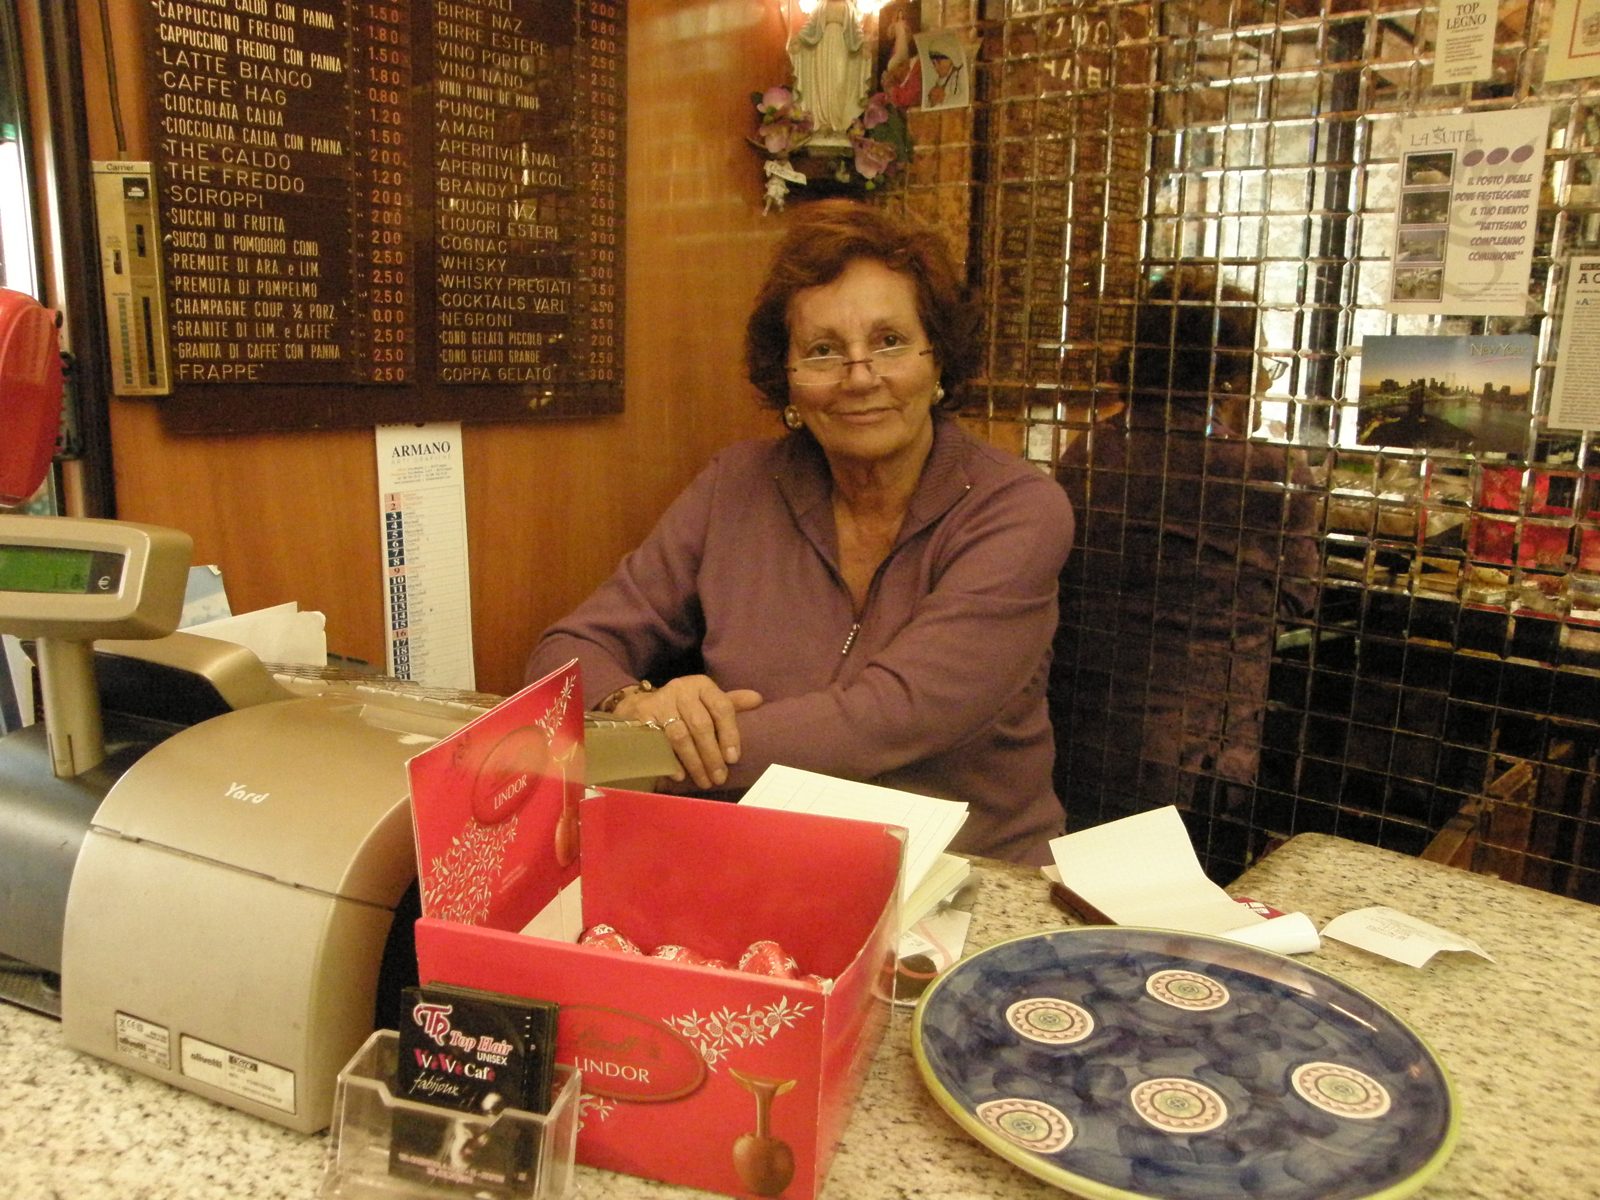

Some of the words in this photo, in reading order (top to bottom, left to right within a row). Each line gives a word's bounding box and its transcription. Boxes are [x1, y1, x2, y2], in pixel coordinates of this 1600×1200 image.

[235, 0, 268, 16] CALDO
[276, 3, 296, 22] CON
[303, 9, 335, 30] PANNA
[439, 1, 483, 24] BIRRE
[1456, 2, 1479, 16] TOP
[158, 0, 240, 32] CAPPUCCINO
[249, 19, 294, 43] FREDDO
[1446, 13, 1487, 30] LEGNO
[160, 23, 228, 53] CAPPUCCINO
[236, 38, 276, 62] FREDDO
[283, 48, 303, 67] CON
[311, 53, 342, 73] PANNA
[439, 21, 483, 42] BIRRE
[493, 33, 547, 56] ESTERE
[439, 42, 474, 60] VINO
[482, 49, 528, 70] PORTO
[163, 47, 228, 75] LATTE
[240, 61, 312, 89] BIANCO
[439, 60, 475, 79] VINO
[245, 84, 287, 106] HAG
[440, 80, 460, 96] VINO
[165, 93, 239, 121] CIOCCOLATA
[246, 106, 284, 127] CALDA
[440, 99, 495, 121] PUNCH
[166, 117, 235, 142] CIOCCOLATA
[243, 127, 277, 148] CALDA
[284, 133, 304, 151] CON
[311, 136, 343, 156] PANNA
[440, 120, 494, 140] AMARI
[106, 163, 135, 172] Carrier
[222, 147, 291, 171] CALDO
[223, 168, 305, 193] FREDDO
[440, 177, 506, 198] BRANDY
[170, 185, 263, 210] SCIROPPI
[171, 207, 216, 228] SUCCHI
[224, 213, 236, 229] DI
[244, 215, 285, 233] FRUTTA
[441, 215, 500, 234] LIQUORI
[508, 223, 558, 240] ESTERI
[172, 231, 206, 250] SUCCO
[215, 235, 225, 250] DI
[441, 236, 507, 254] COGNAC
[173, 253, 229, 272] PREMUTE
[237, 257, 249, 273] DI
[441, 256, 506, 272] WHISKY
[175, 276, 231, 294] PREMUTA
[238, 280, 250, 295] DI
[258, 279, 318, 298] POMPELMO
[440, 274, 502, 290] WHISKY
[508, 278, 571, 294] PREGIATI
[175, 298, 247, 317] CHAMPAGNE
[442, 292, 526, 310] COCKTAILS
[533, 297, 564, 312] VARI
[177, 320, 229, 337] GRANITE
[236, 323, 248, 338] DI
[442, 312, 512, 327] NEGRONI
[442, 331, 466, 344] CONO
[472, 331, 503, 345] GELATO
[509, 332, 542, 345] PICCOLO
[178, 342, 222, 359] GRANITA
[229, 343, 240, 359] DI
[285, 343, 304, 359] CON
[311, 344, 341, 359] PANNA
[442, 349, 466, 363] CONO
[472, 349, 503, 363] GELATO
[509, 350, 540, 363] GRANDE
[443, 368, 491, 381] COPPA
[498, 368, 551, 381] GELATO
[391, 440, 451, 458] ARMANO
[224, 782, 270, 804] Yard
[494, 774, 527, 810] LINDOR
[449, 1030, 477, 1053] Top
[477, 1035, 514, 1056] Hair
[476, 1052, 508, 1066] UNISEX
[574, 1056, 650, 1083] LINDOR
